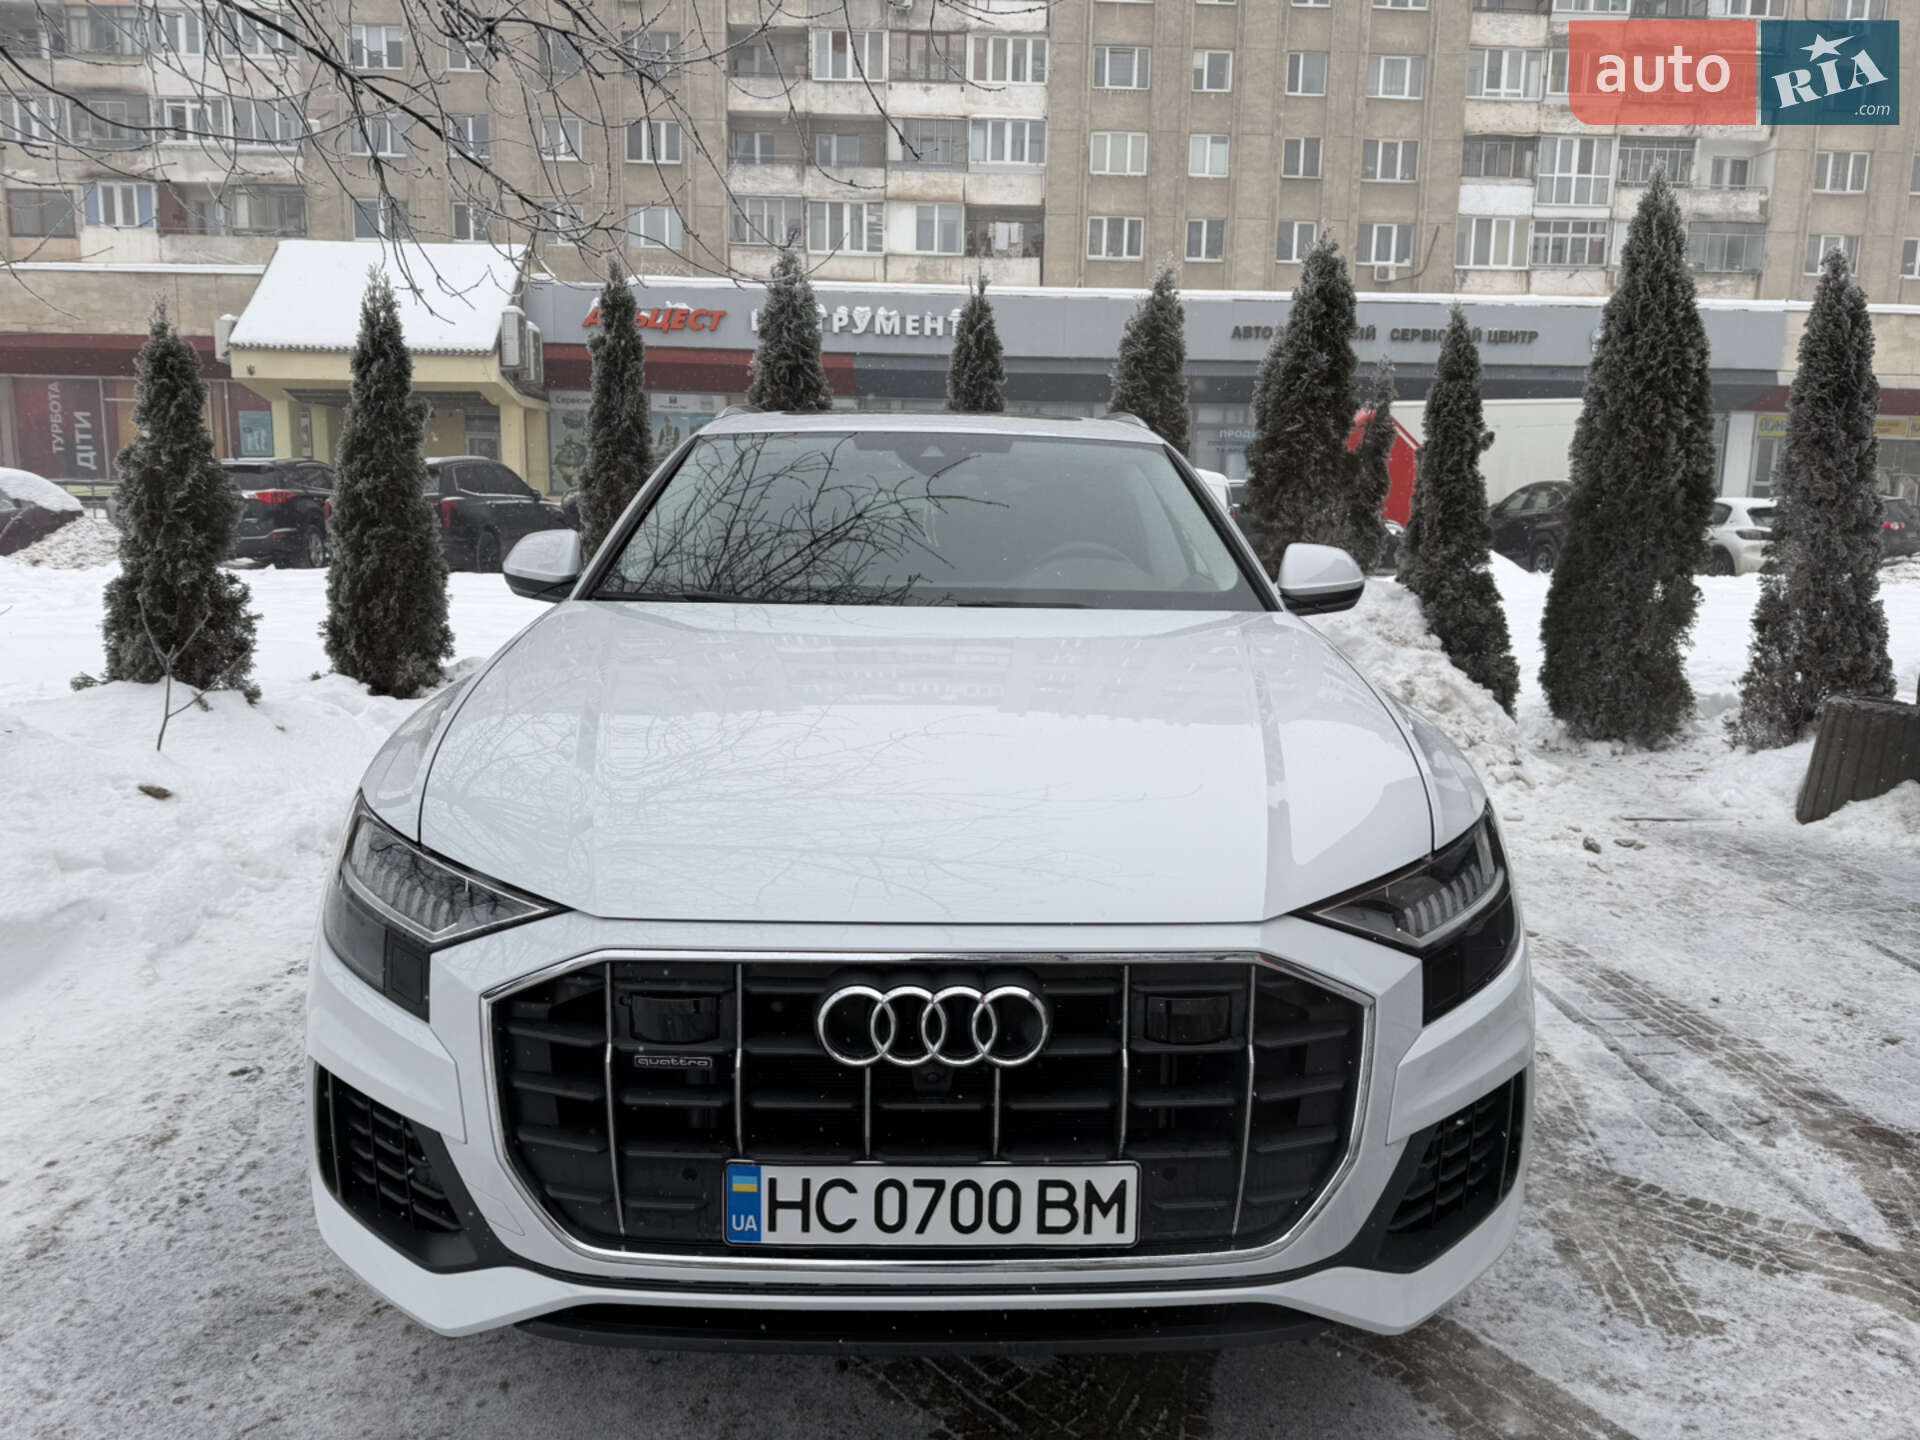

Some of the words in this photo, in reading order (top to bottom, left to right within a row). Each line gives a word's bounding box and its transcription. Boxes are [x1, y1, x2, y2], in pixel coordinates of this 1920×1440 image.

[583, 308, 727, 333] АЬЦЕСТ
[1487, 330, 1539, 344] ЦЕНТР
[48, 382, 64, 453] ТУРБОТА
[73, 411, 97, 470] ДІТИ
[637, 1057, 708, 1066] quattro
[767, 1177, 857, 1234] HC
[873, 1178, 1022, 1235] 0700
[1036, 1179, 1128, 1235] BM
[732, 1215, 757, 1232] UA
